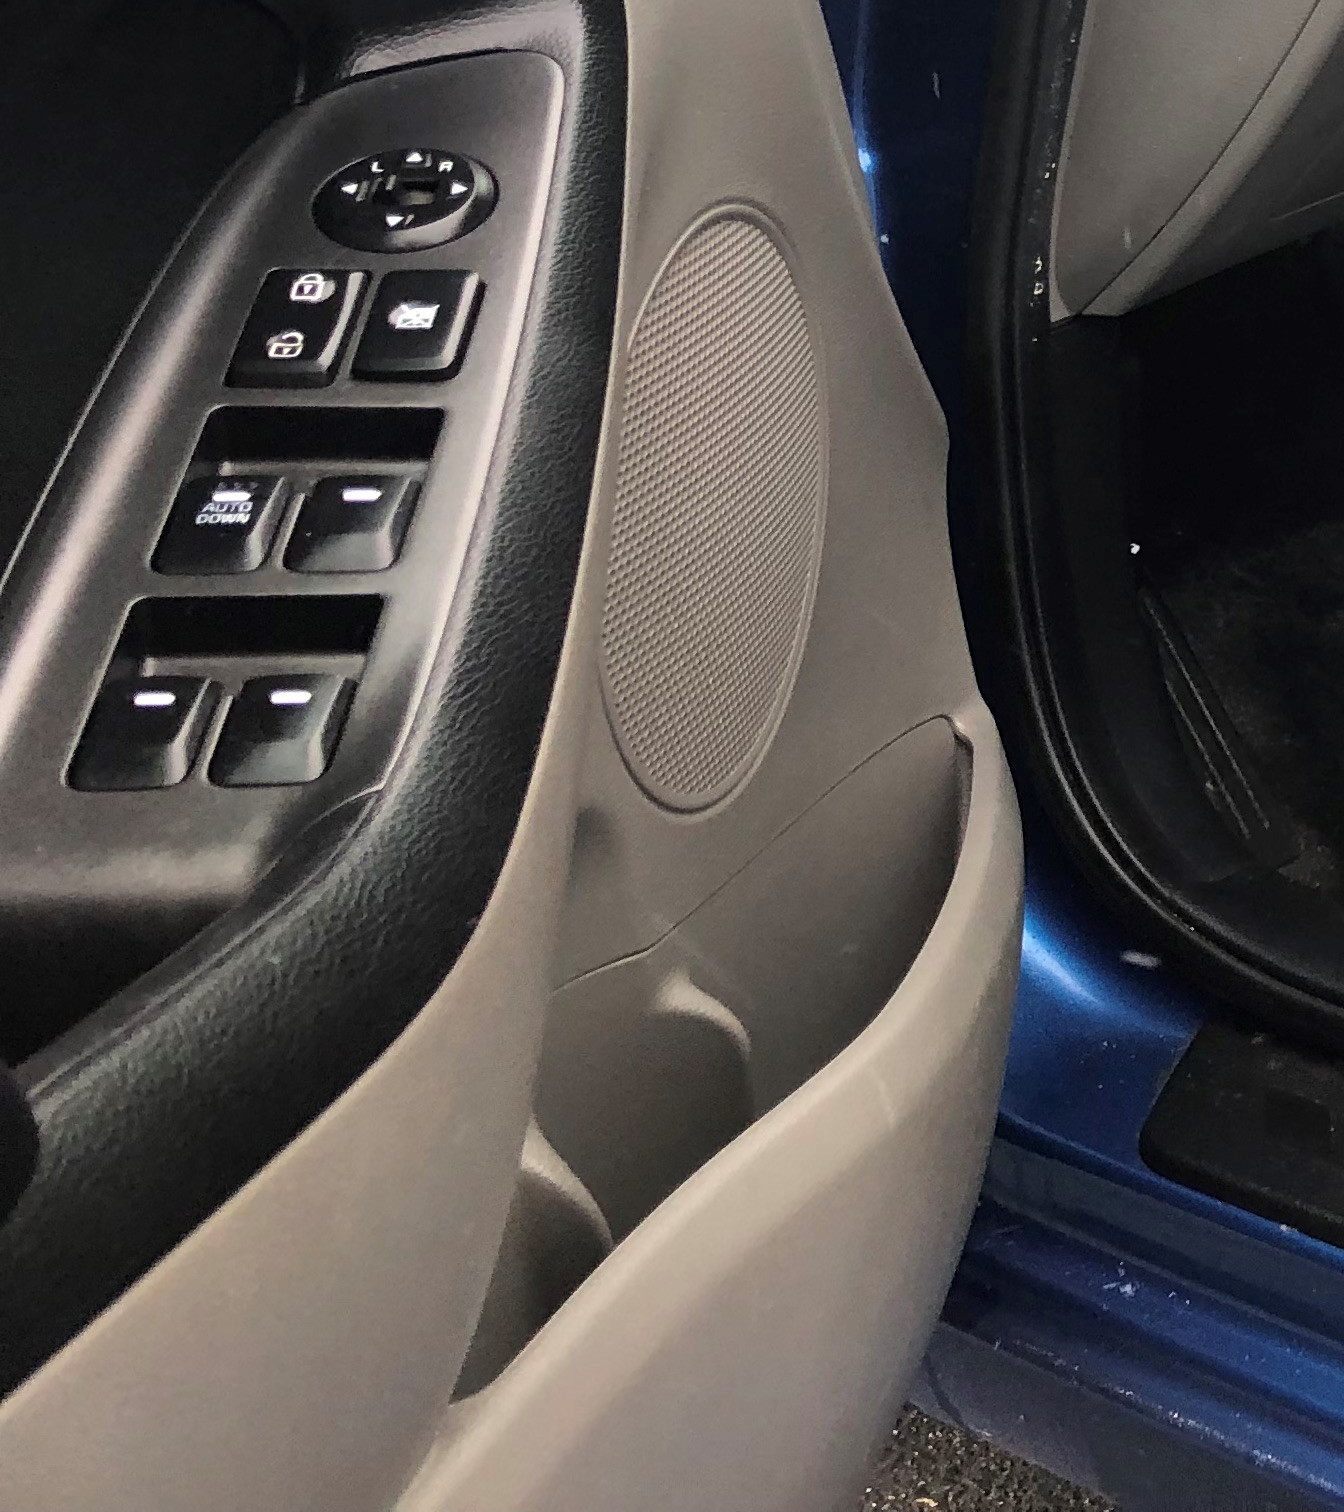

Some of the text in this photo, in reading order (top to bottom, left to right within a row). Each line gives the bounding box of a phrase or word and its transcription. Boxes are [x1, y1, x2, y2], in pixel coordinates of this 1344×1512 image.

[370, 160, 454, 173] L R
[201, 501, 254, 513] AUTO
[195, 512, 252, 524] DOWN
